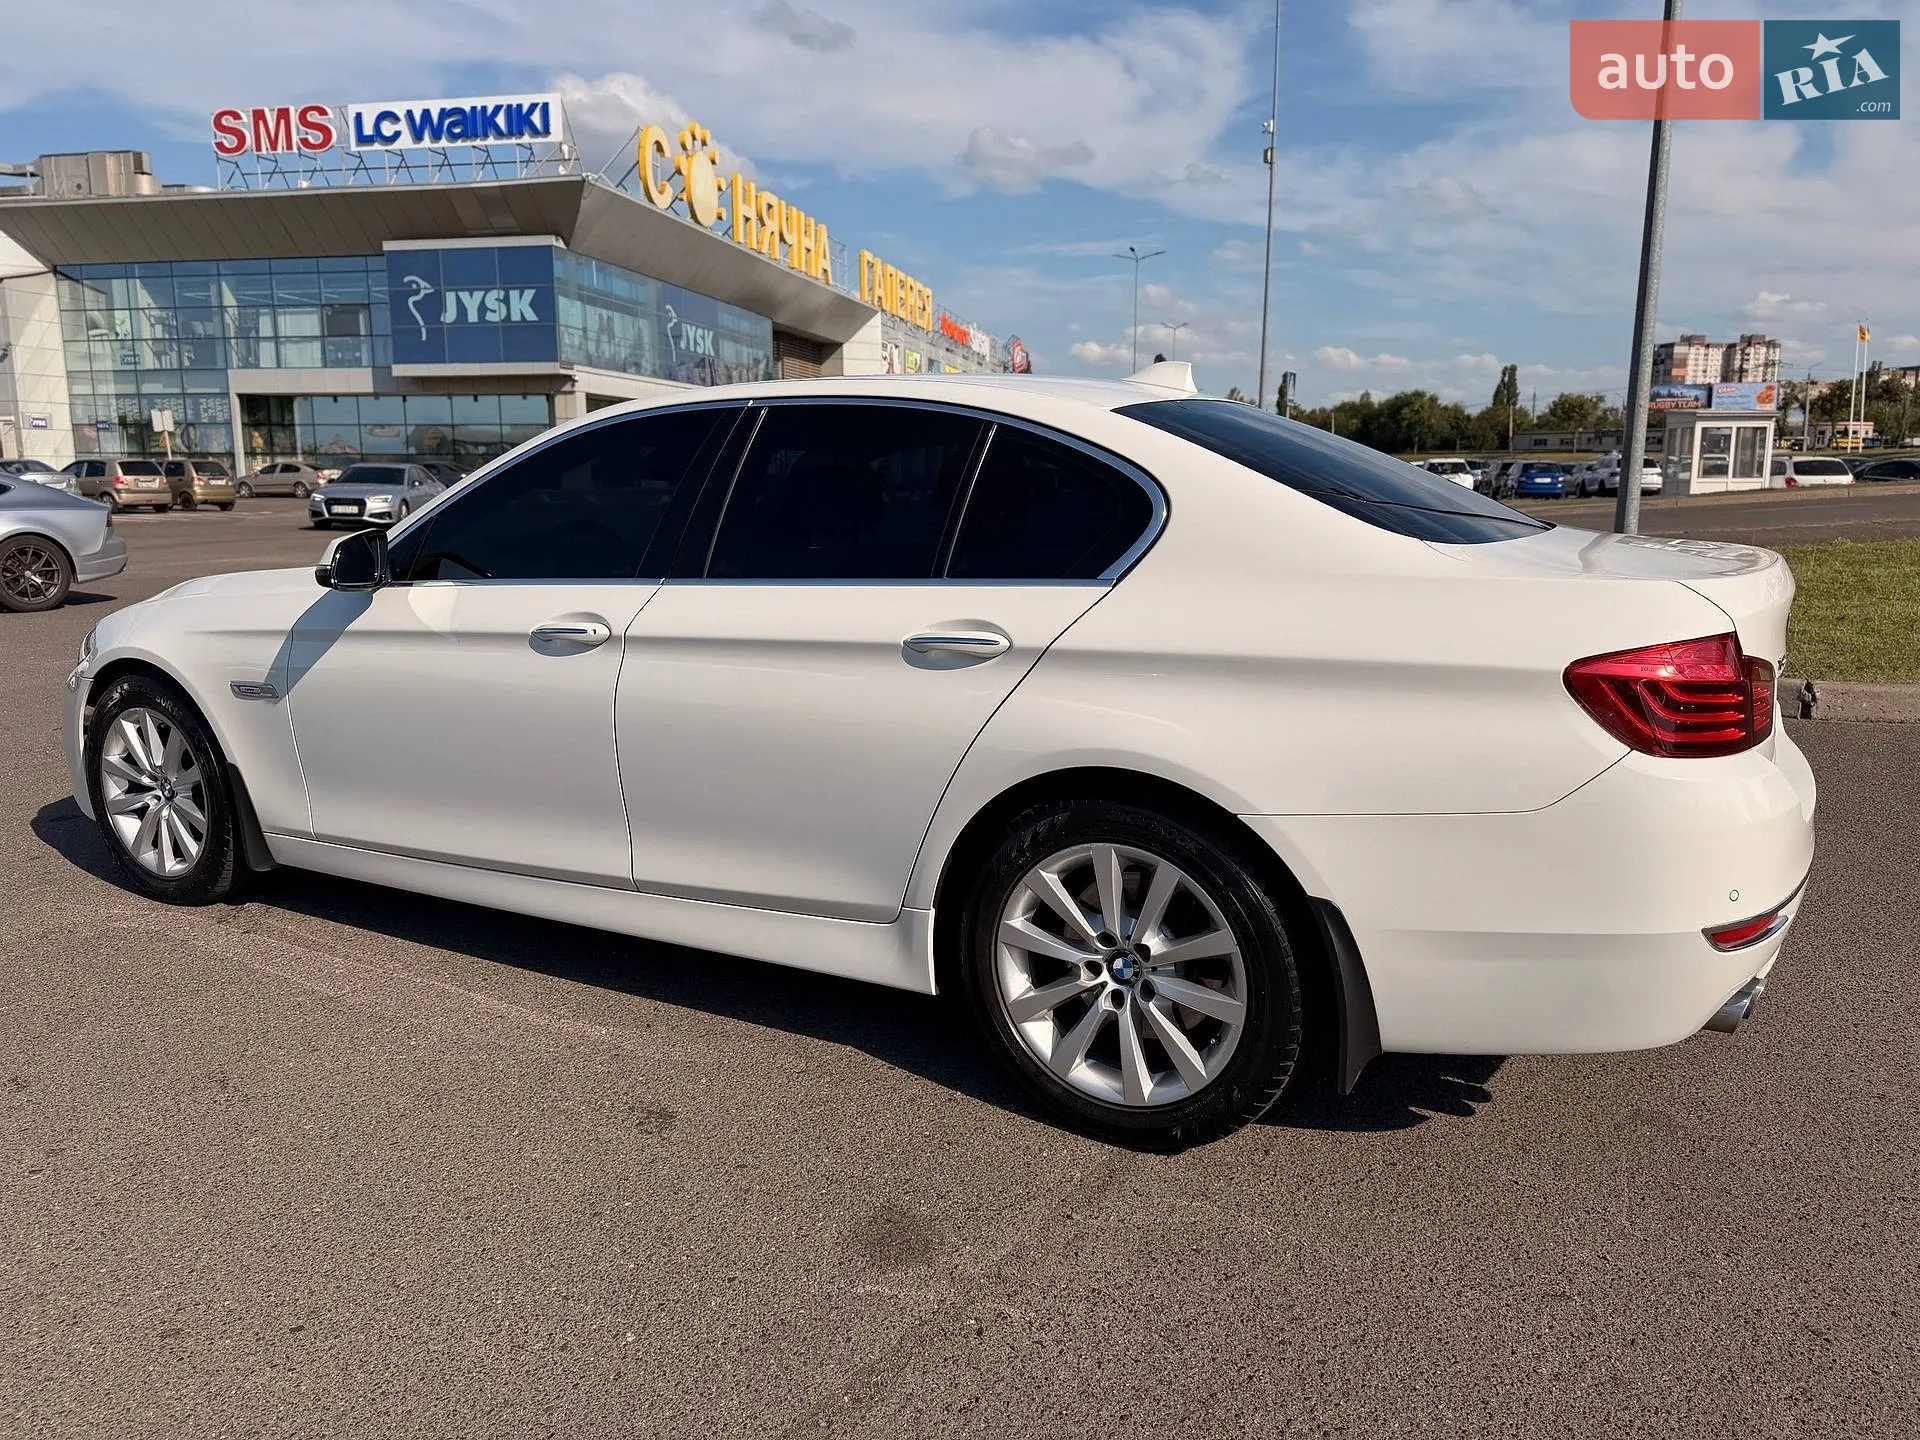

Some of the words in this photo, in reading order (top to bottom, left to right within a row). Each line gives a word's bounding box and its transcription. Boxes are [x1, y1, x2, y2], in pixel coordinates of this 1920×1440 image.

[211, 104, 336, 156] SMS
[355, 109, 402, 146] LC
[440, 288, 539, 323] JYSK
[858, 249, 933, 332] ГАЛЕРЕЯ
[679, 323, 715, 356] JYSK
[1677, 400, 1701, 409] TEAM
